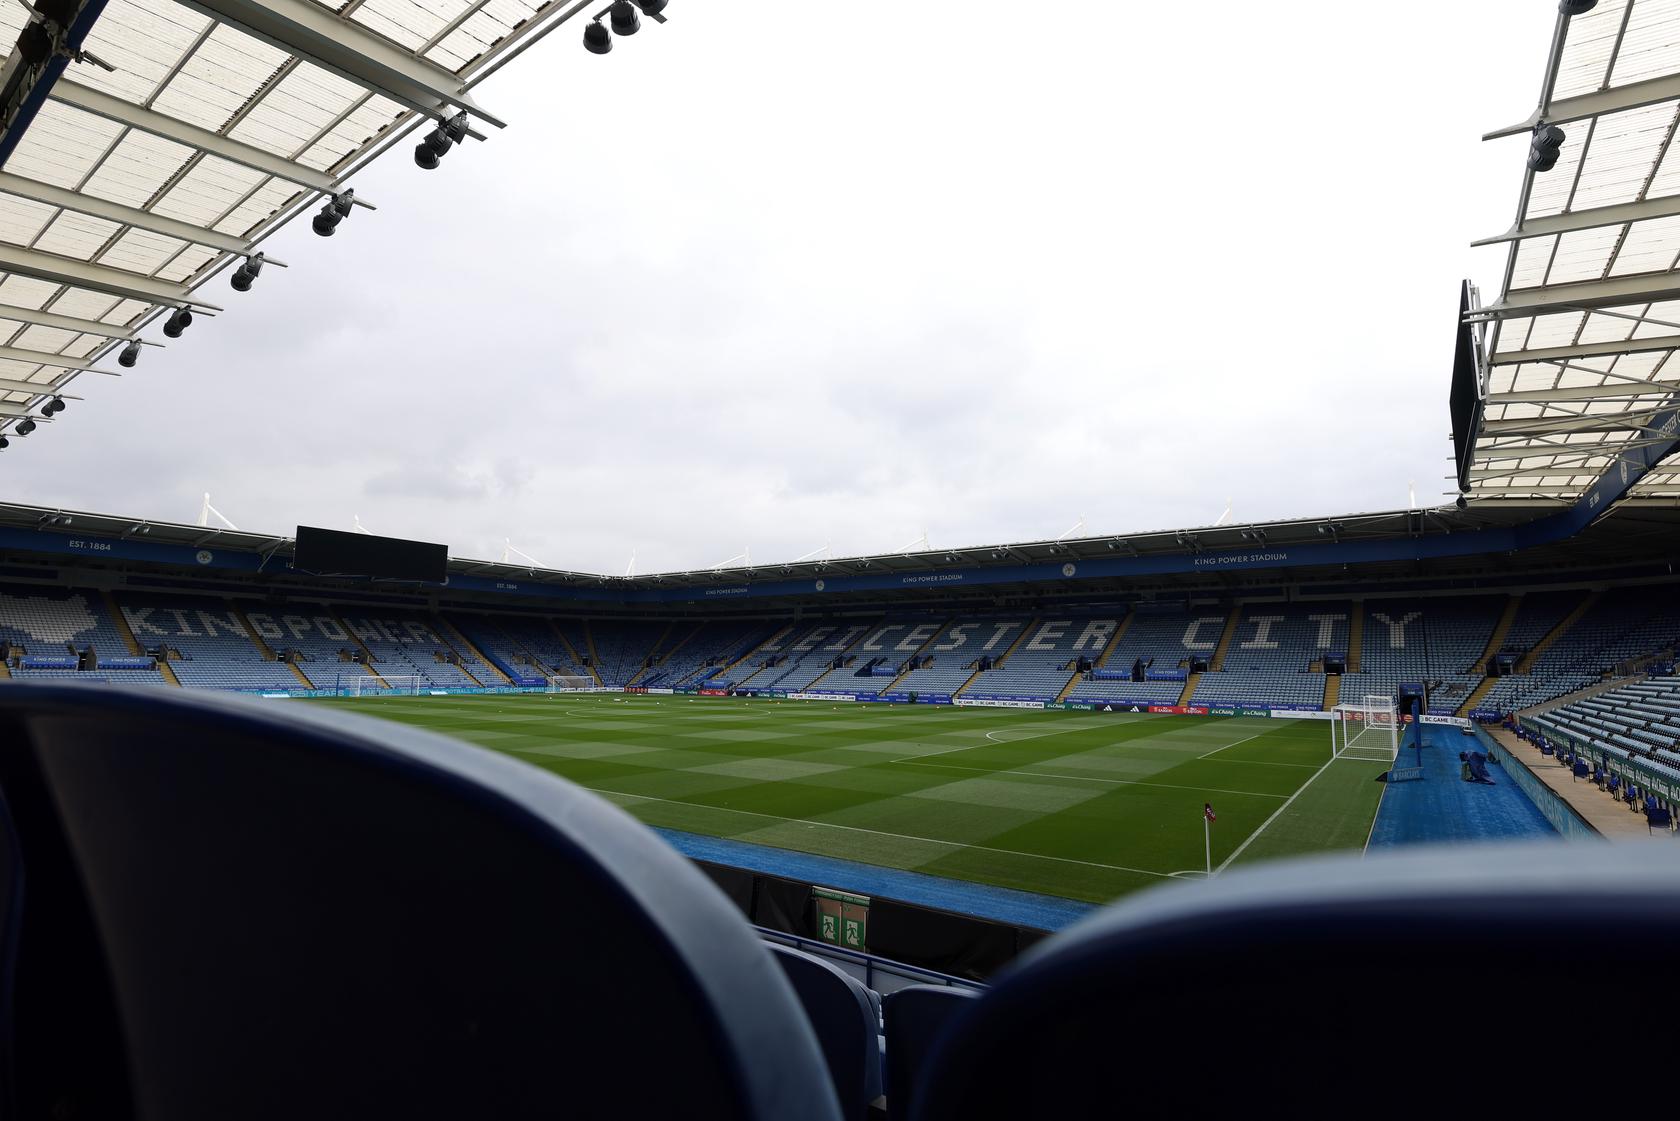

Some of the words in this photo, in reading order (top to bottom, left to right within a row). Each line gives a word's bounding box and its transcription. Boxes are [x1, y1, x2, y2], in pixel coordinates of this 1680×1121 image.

[69, 540, 87, 549] EST.
[90, 542, 111, 551] 1884
[1194, 558, 1216, 566] KING
[1218, 555, 1248, 564] POWER
[1250, 553, 1287, 562] STADIUM
[760, 619, 1118, 650] LEICESTER
[1182, 612, 1422, 650] CITY
